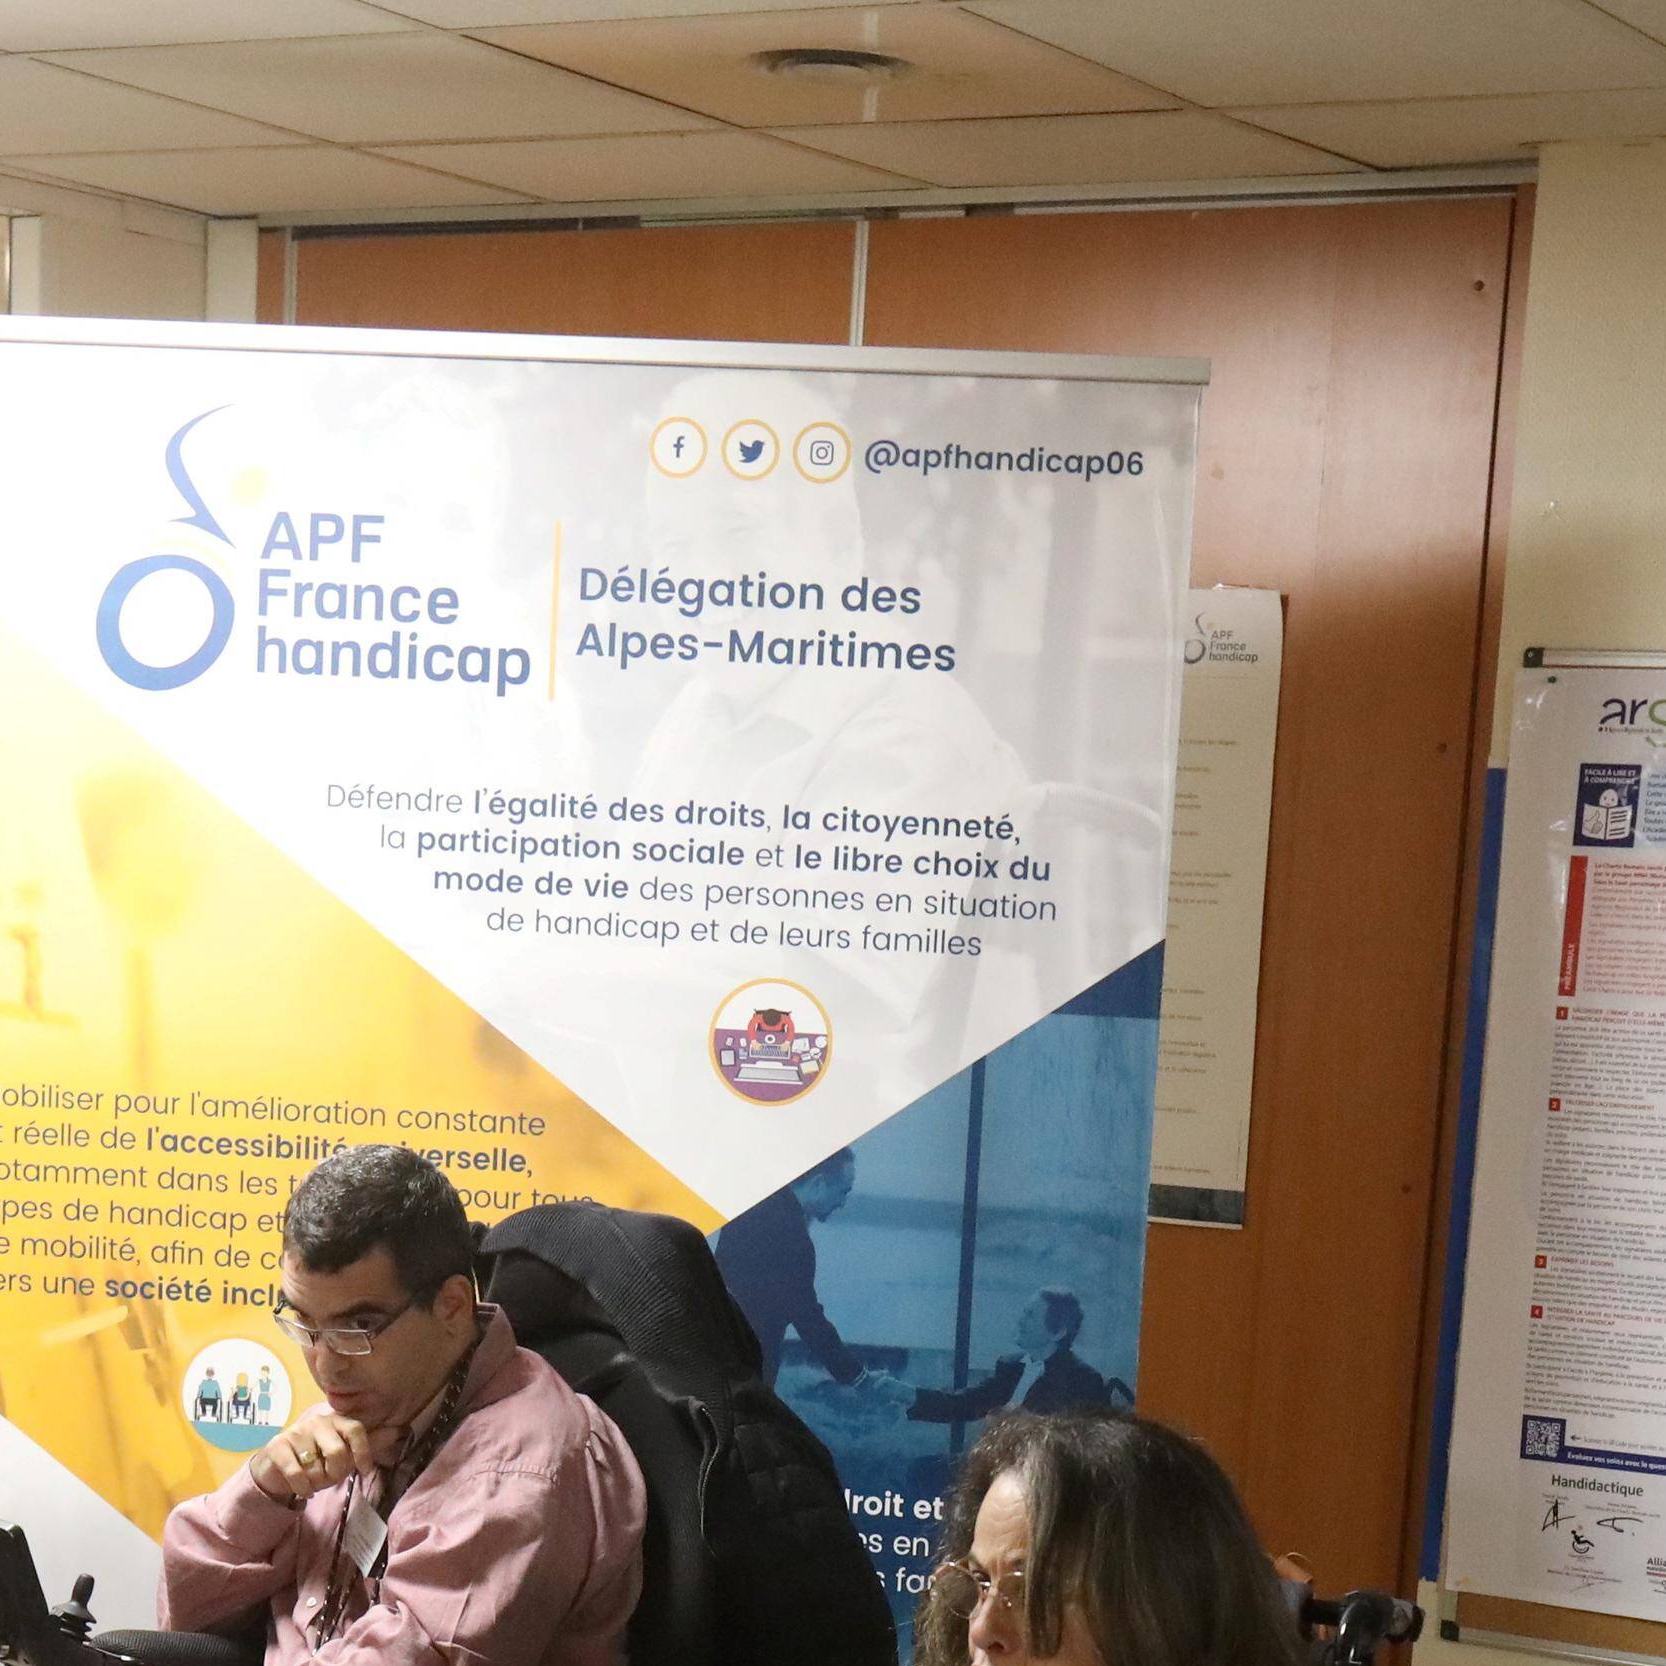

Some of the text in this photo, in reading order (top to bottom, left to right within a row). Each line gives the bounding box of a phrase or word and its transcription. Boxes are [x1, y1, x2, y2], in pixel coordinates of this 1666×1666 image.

[864, 439, 1144, 482] @apfhandicap06
[260, 511, 385, 563] APF
[258, 568, 459, 625] France
[579, 565, 922, 617] Délégation des
[576, 622, 956, 672] Alpes-Maritimes
[1209, 641, 1247, 651] France
[1211, 630, 1234, 641] APF
[257, 625, 530, 697] handicap
[327, 784, 1021, 846] Défendre l'égalité des droits, la citoyenneté,
[380, 824, 1051, 882] la participation sociale et le libre choix du
[434, 868, 1057, 921] mode de vie des personnes en situation
[486, 907, 982, 956] de handicap et de leurs familles
[14, 1120, 90, 1147] réelle
[100, 1126, 137, 1150] de
[114, 1093, 181, 1119] pour
[191, 1091, 386, 1127] l'amélioration
[397, 1109, 546, 1136] constante
[157, 1166, 229, 1193] dans
[240, 1170, 278, 1195] les
[456, 1188, 521, 1210] pour
[63, 1198, 99, 1223] de
[110, 1200, 247, 1237] handicap
[257, 1211, 284, 1234] et
[21, 1235, 141, 1266] mobilité,
[151, 1240, 204, 1266] afin
[214, 1244, 251, 1269] de
[42, 1274, 95, 1297] une
[105, 1275, 213, 1303] société
[222, 1280, 281, 1307] incl
[913, 1496, 945, 1520] et
[1551, 1474, 1644, 1498] Handidactique
[893, 1535, 929, 1557] en
